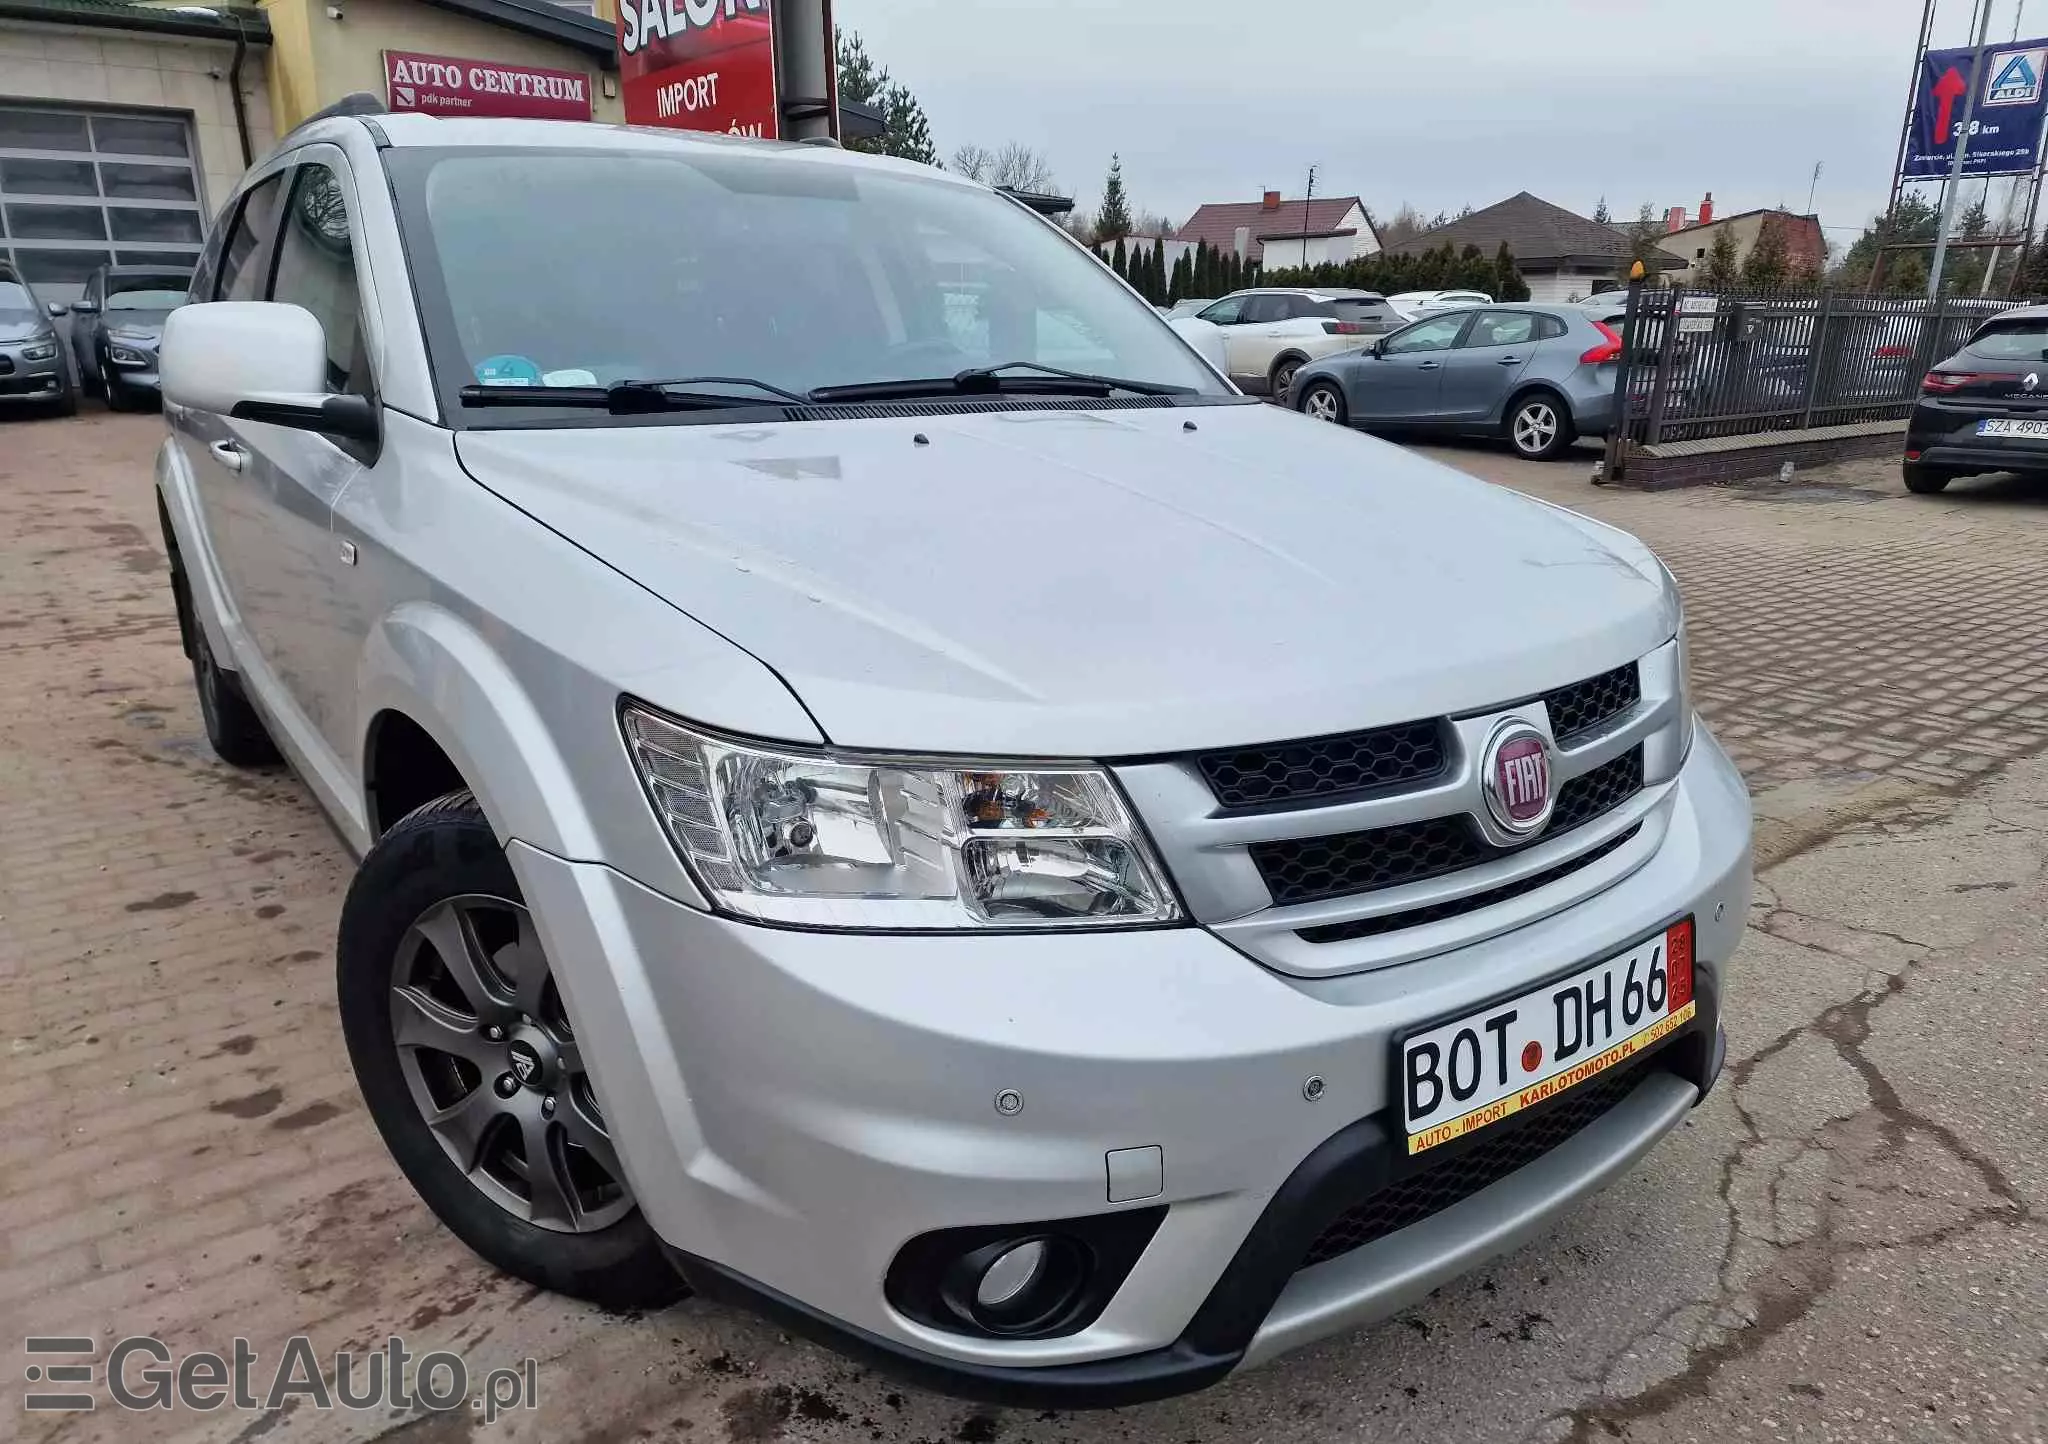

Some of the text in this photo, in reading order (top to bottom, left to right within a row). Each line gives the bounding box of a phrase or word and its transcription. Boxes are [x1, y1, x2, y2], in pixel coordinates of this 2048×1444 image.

[393, 60, 584, 101] AUTO CENTRUM
[421, 94, 472, 108] pdk partner
[657, 72, 718, 118] IMPORT
[1993, 88, 2032, 100] ALDI
[1982, 124, 2000, 135] km
[1986, 420, 2011, 433] SZA
[1504, 752, 1543, 807] FIAT
[1406, 945, 1667, 1121] BOT DH 66
[1416, 1126, 1451, 1151] AUTO
[1462, 1101, 1508, 1132] IMPORT
